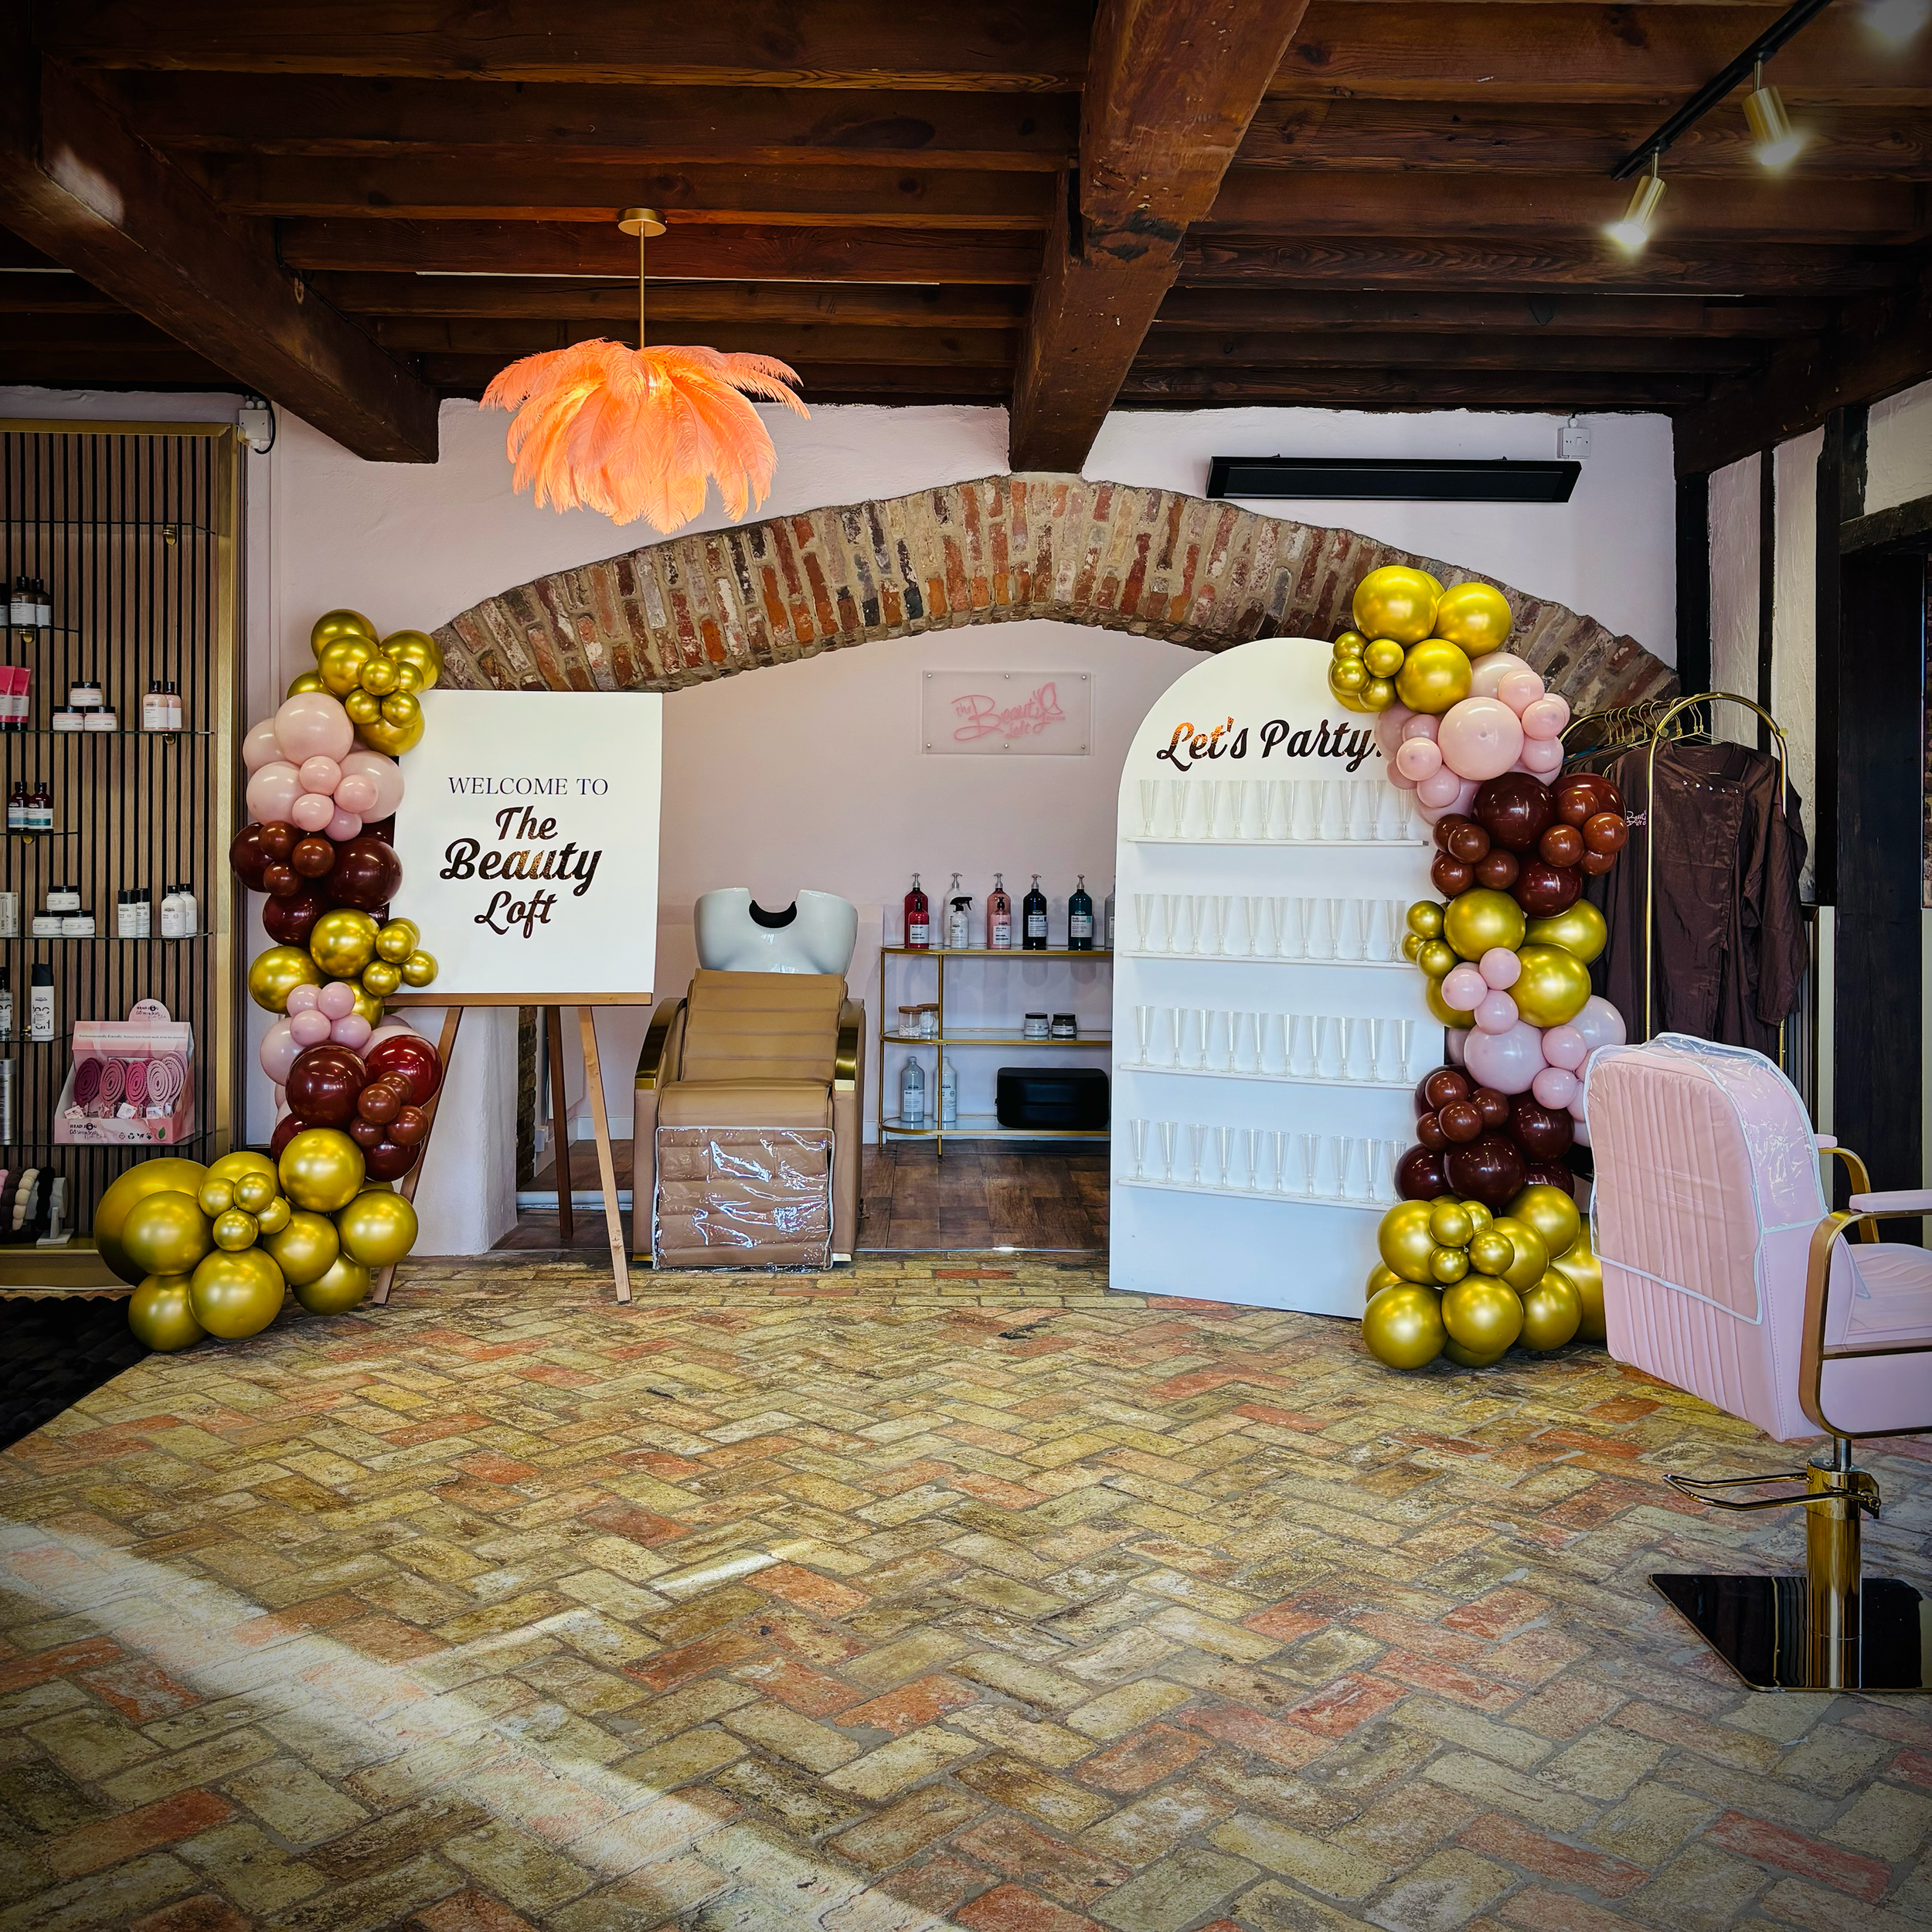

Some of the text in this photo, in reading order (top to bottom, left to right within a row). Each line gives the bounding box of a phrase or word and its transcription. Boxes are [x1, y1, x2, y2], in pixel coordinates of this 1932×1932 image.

[955, 702, 973, 717] the
[1156, 716, 1382, 774] Let's Party
[448, 777, 608, 795] WELCOME TO
[495, 805, 558, 841] The
[439, 838, 603, 896] Beauty
[474, 889, 558, 939] Loft
